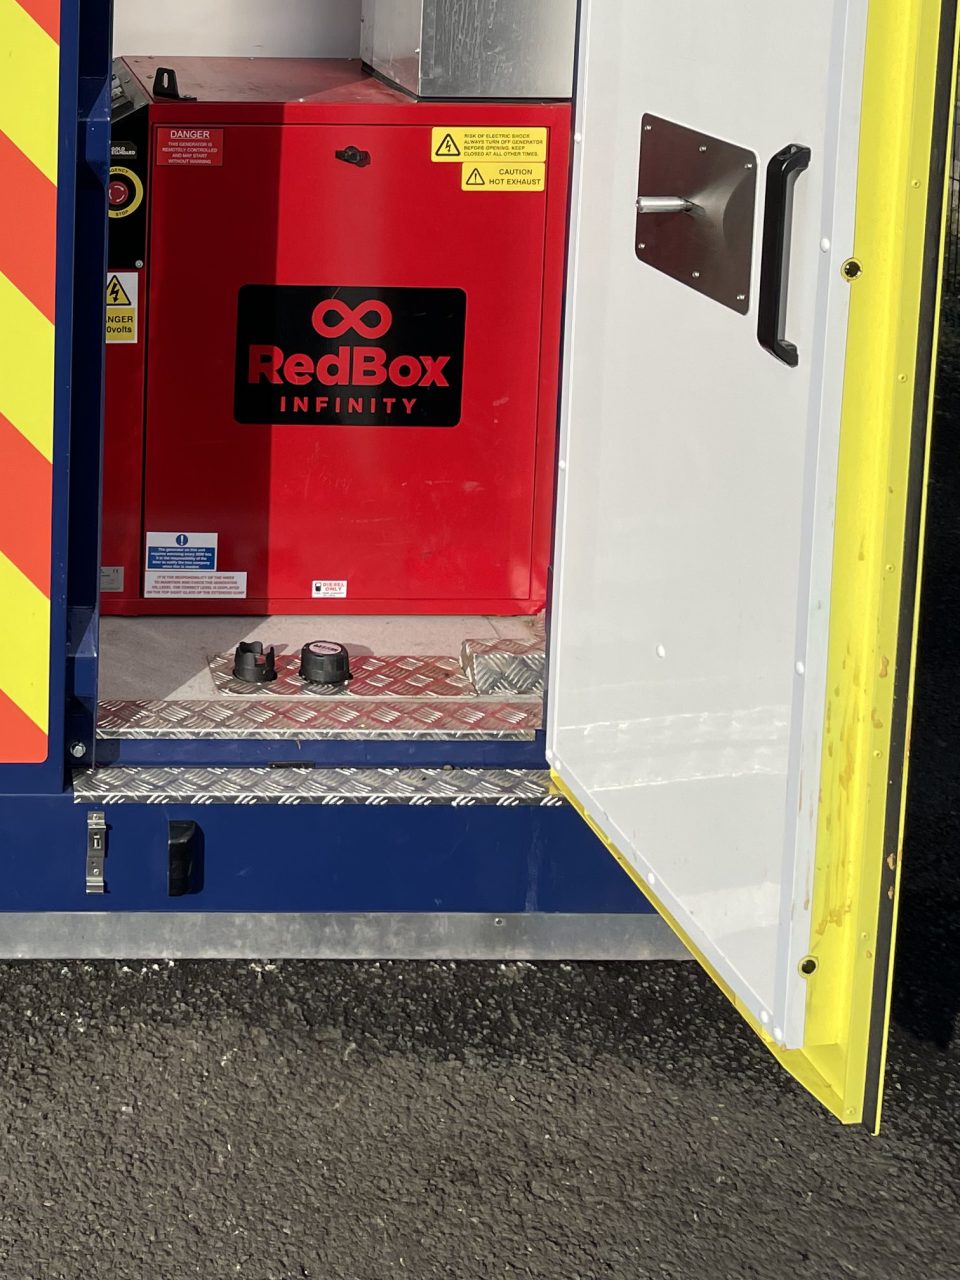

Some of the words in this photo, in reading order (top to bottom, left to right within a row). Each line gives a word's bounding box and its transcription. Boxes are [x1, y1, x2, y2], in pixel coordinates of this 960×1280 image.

[171, 130, 209, 139] DANGER
[248, 345, 450, 387] RedBox
[280, 396, 416, 413] INFINITY
